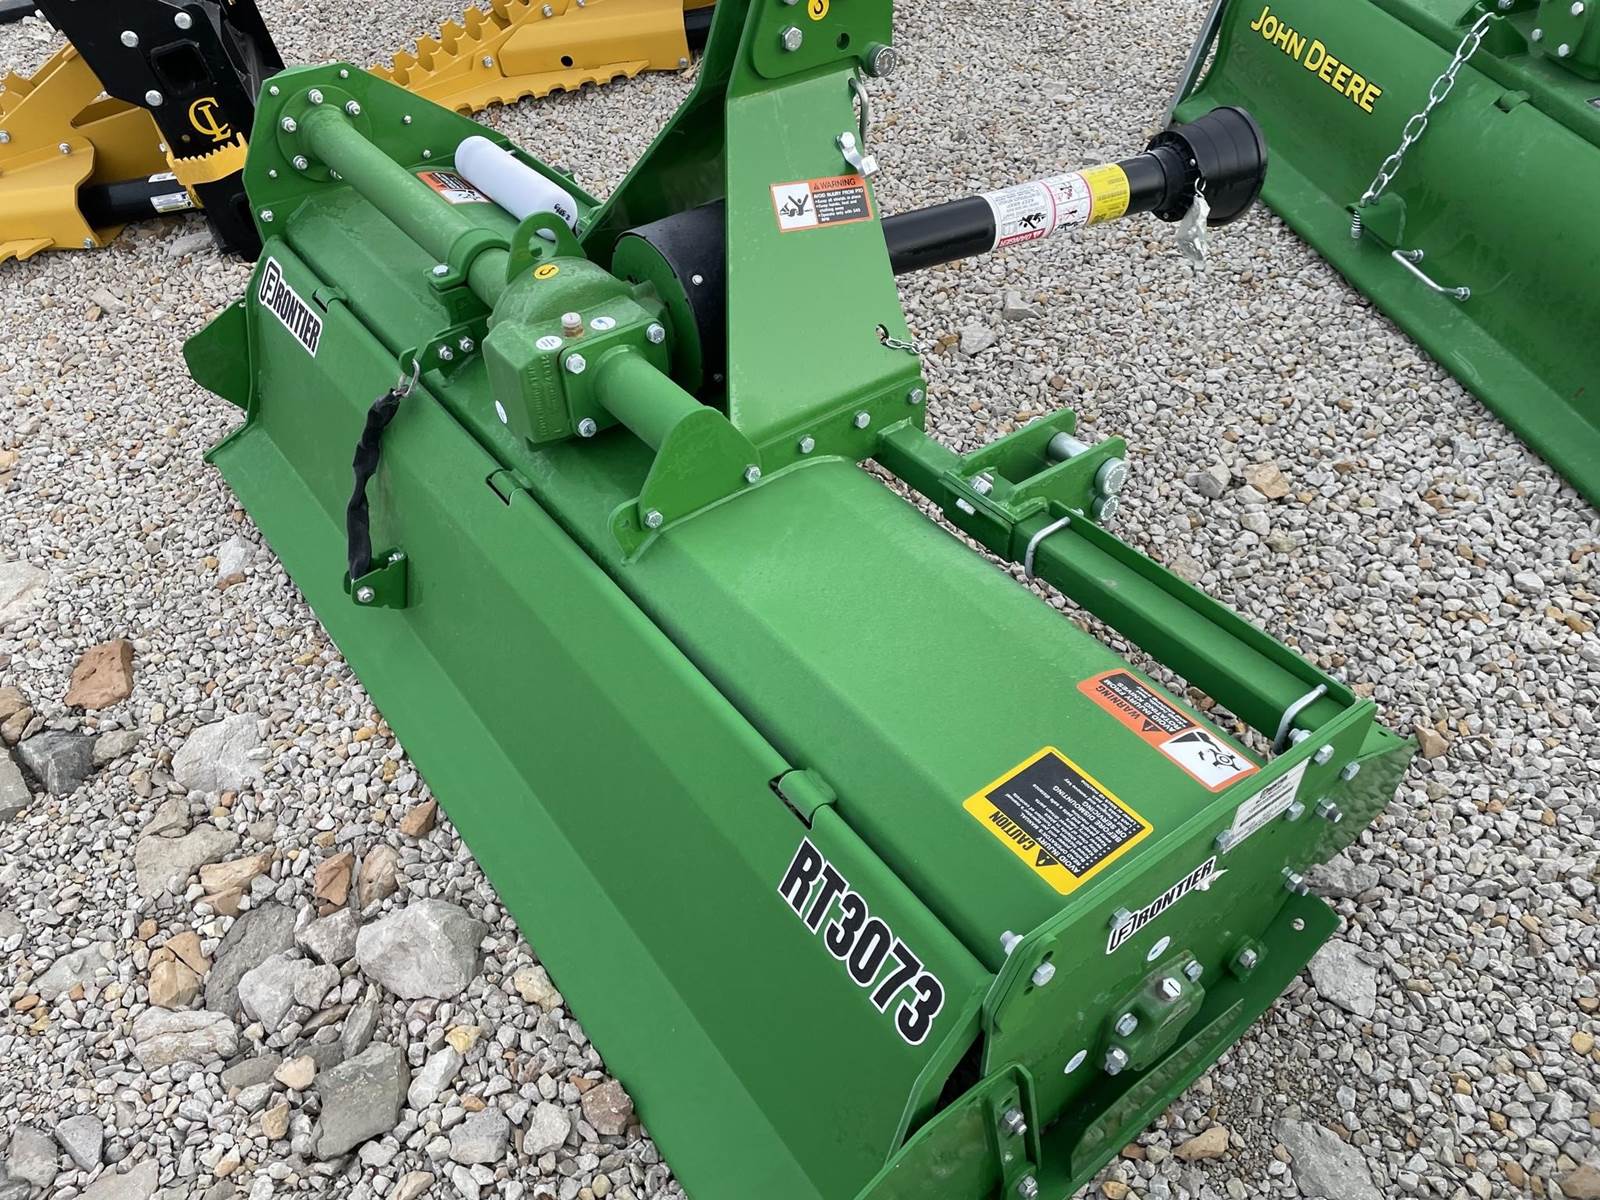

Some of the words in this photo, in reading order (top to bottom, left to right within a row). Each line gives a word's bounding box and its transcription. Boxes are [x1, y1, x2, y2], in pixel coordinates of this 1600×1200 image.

[1251, 6, 1306, 60] JOHN
[1303, 39, 1382, 113] DEERE
[822, 178, 855, 188] WARNING
[260, 261, 320, 352] FRONTIER
[1102, 679, 1126, 695] FROM
[1115, 682, 1145, 702] KNIVES
[1093, 685, 1142, 719] WARNING
[1123, 694, 1153, 715] INJURY
[1142, 702, 1182, 729] ROTATING
[1150, 714, 1177, 732] AVOID
[1062, 777, 1073, 785] key
[1031, 782, 1050, 798] distance
[1071, 784, 1088, 798] remove
[1033, 797, 1047, 808] parts
[1048, 797, 1060, 806] safe
[1051, 784, 1096, 821] DISMOUNTING
[1086, 797, 1097, 805] and
[1043, 812, 1057, 823] place
[1044, 807, 1060, 820] driven
[1061, 808, 1073, 817] pets
[1070, 808, 1090, 825] machine
[1080, 800, 1117, 830] SERVICING
[1018, 812, 1039, 829] MANUAL
[1058, 818, 1073, 830] power
[1064, 817, 1079, 829] riders
[1071, 815, 1082, 824] and
[988, 810, 1036, 851] CAUTION
[1050, 825, 1060, 833] and
[1059, 826, 1077, 841] shields
[1077, 828, 1090, 838] carry
[1079, 823, 1096, 836] people
[1088, 823, 1100, 833] from
[1092, 818, 1122, 843] BEFORE
[1114, 827, 1127, 838] OR
[1037, 828, 1069, 854] OPERATOR'S
[1055, 836, 1071, 849] power
[1076, 833, 1089, 844] clear
[1088, 837, 1103, 849] Never
[1094, 835, 1108, 846] Keep
[1035, 835, 1060, 856] INJURY
[1081, 844, 1095, 856] Keep
[1058, 854, 1081, 873] AVOID
[1066, 852, 1082, 865] READ
[1108, 859, 1214, 952] FRONTIER
[780, 839, 944, 1043] RT3073
